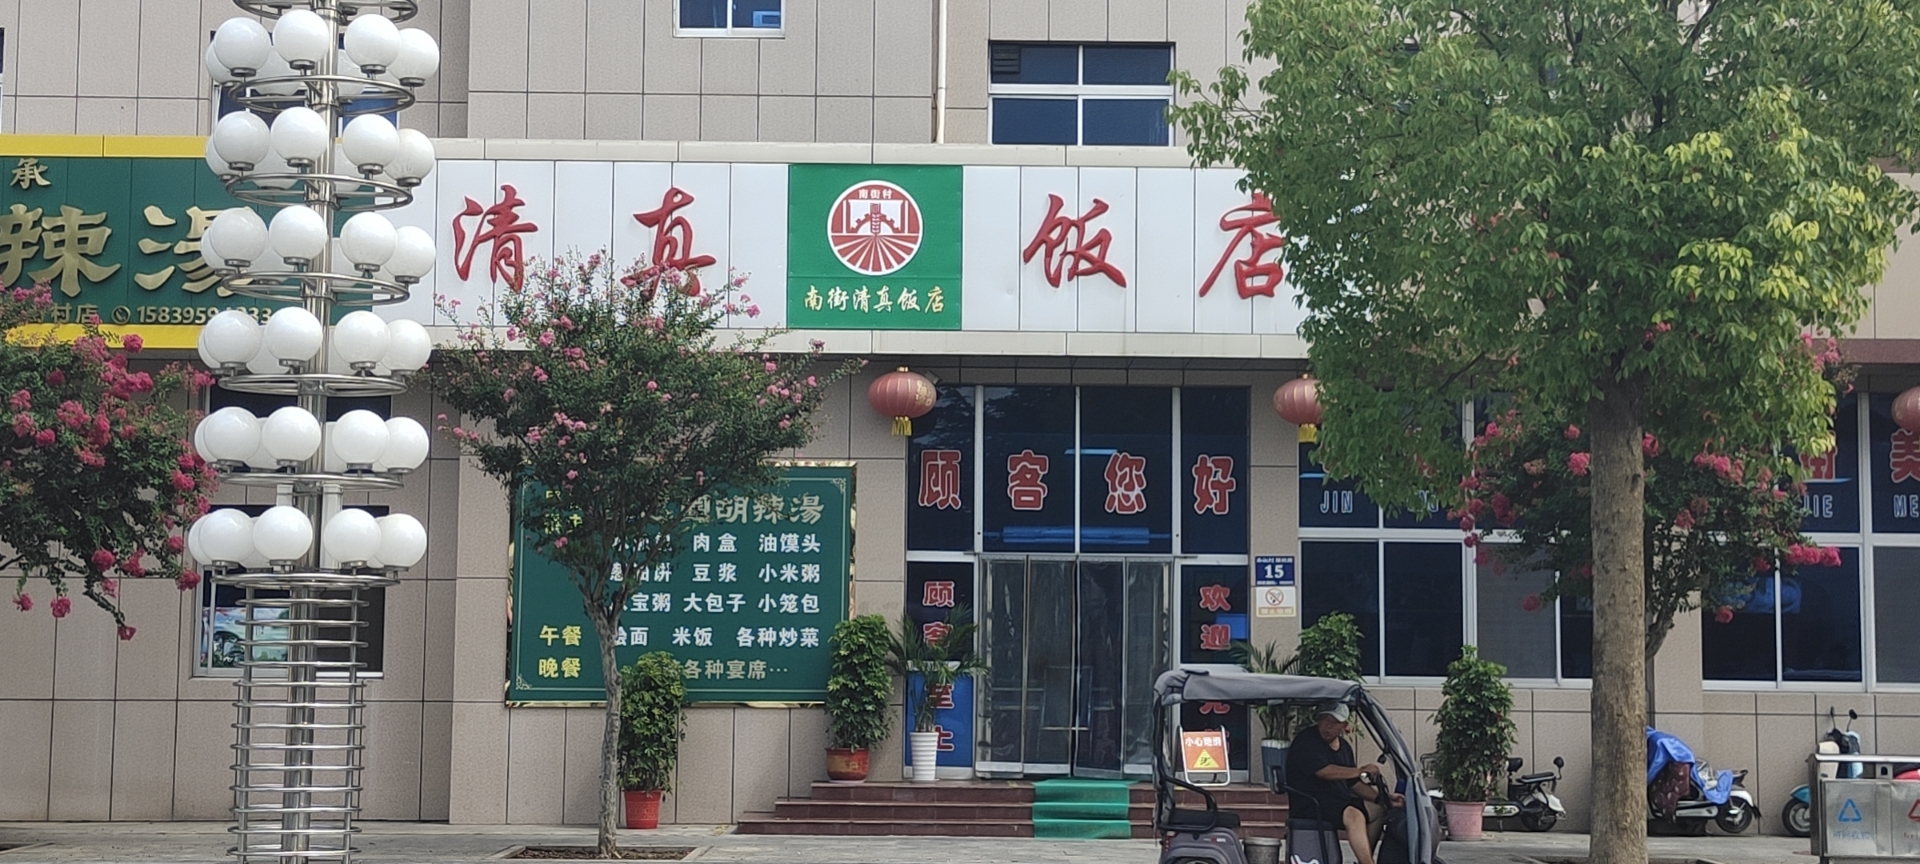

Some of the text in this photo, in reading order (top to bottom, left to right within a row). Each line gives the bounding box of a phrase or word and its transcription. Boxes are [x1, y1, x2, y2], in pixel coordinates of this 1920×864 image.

[10, 158, 51, 190] 承
[804, 285, 945, 313] 南街清真饭店
[137, 306, 272, 324] 158395933
[919, 450, 1236, 515] 顾客您好
[1320, 490, 1353, 514] JIN
[693, 533, 738, 553] 肉盒
[758, 533, 821, 553] 油馍头
[692, 563, 738, 583] 豆浆
[758, 563, 821, 584] 小米粥
[1264, 564, 1284, 579] 15
[683, 592, 746, 613] 大包子
[758, 593, 820, 614] 小笼包
[539, 625, 582, 647] 午餐
[672, 626, 713, 647] 米饭
[736, 627, 820, 648] 各种炒菜
[538, 658, 582, 680] 晚餐
